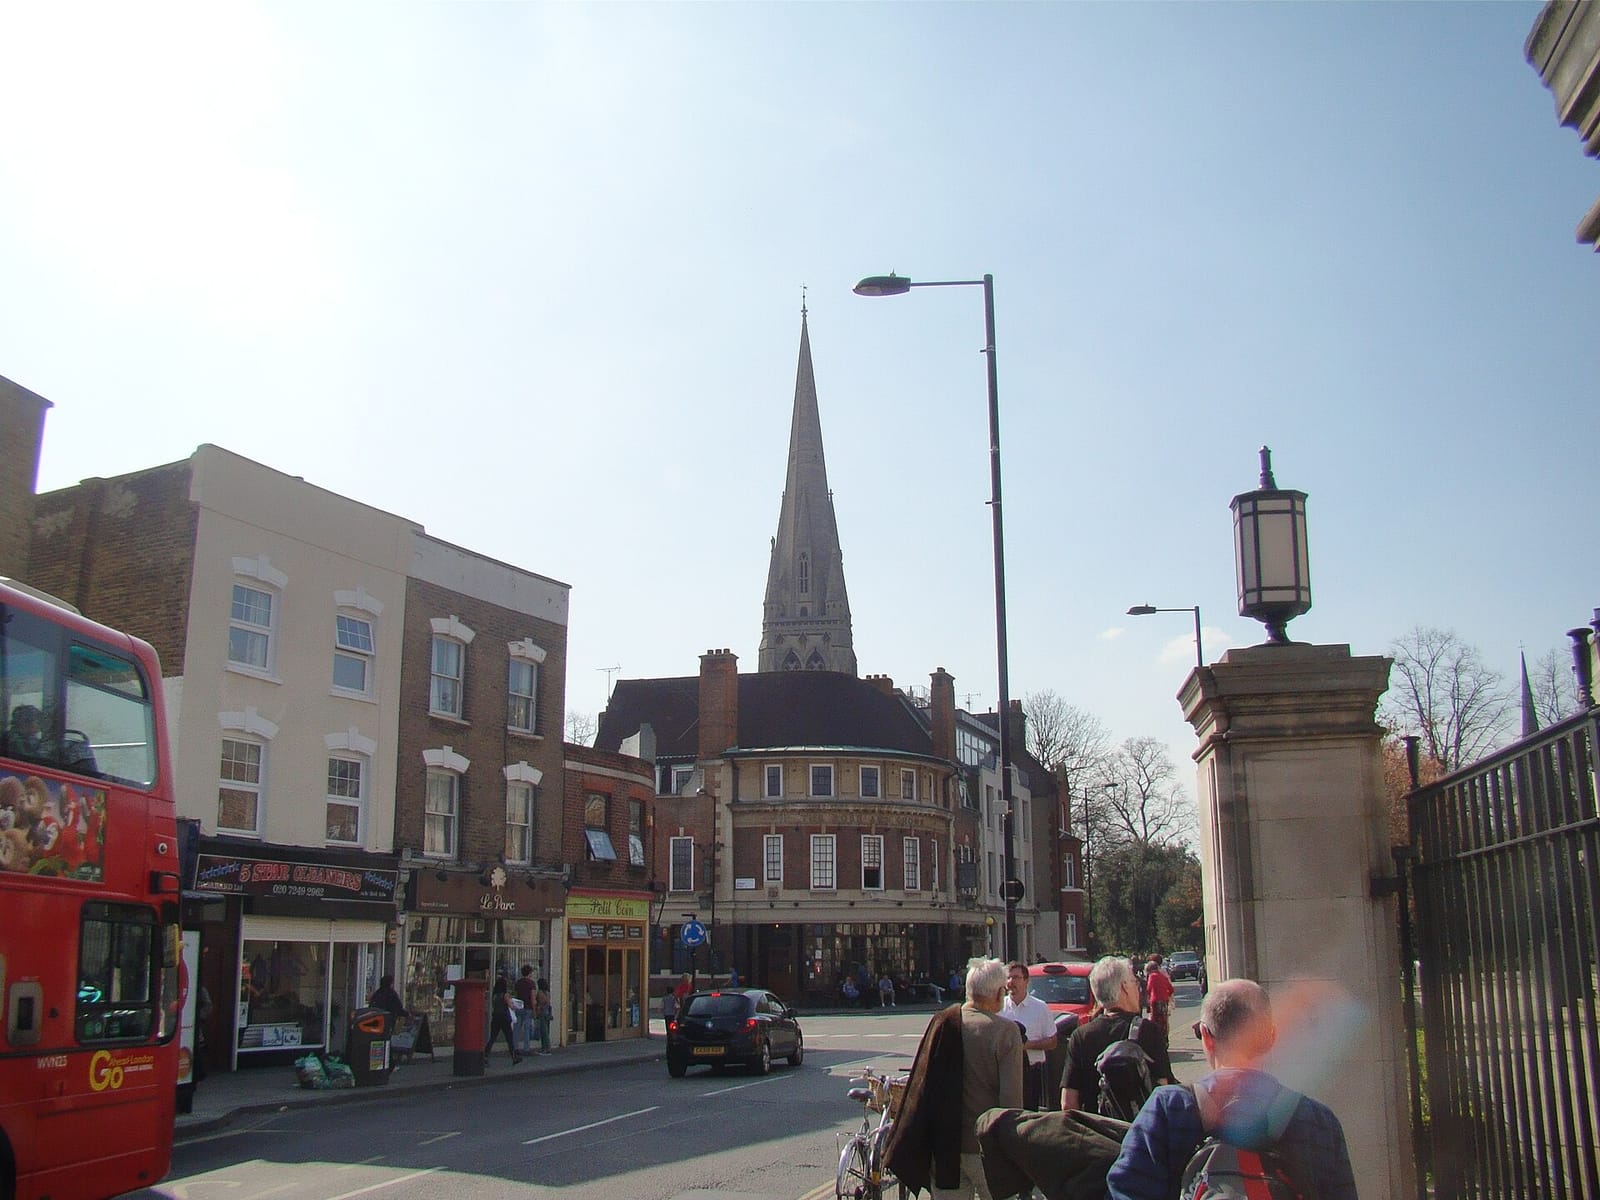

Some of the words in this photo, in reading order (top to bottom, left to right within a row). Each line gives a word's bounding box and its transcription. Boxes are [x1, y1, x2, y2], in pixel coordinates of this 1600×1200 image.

[238, 865, 250, 882] 5
[251, 864, 290, 882] STAR
[292, 866, 362, 892] CLEANERS
[480, 893, 493, 910] Le
[493, 894, 516, 910] Parc
[590, 897, 612, 915] Petit
[615, 898, 634, 916] Coin
[89, 1049, 124, 1091] Go
